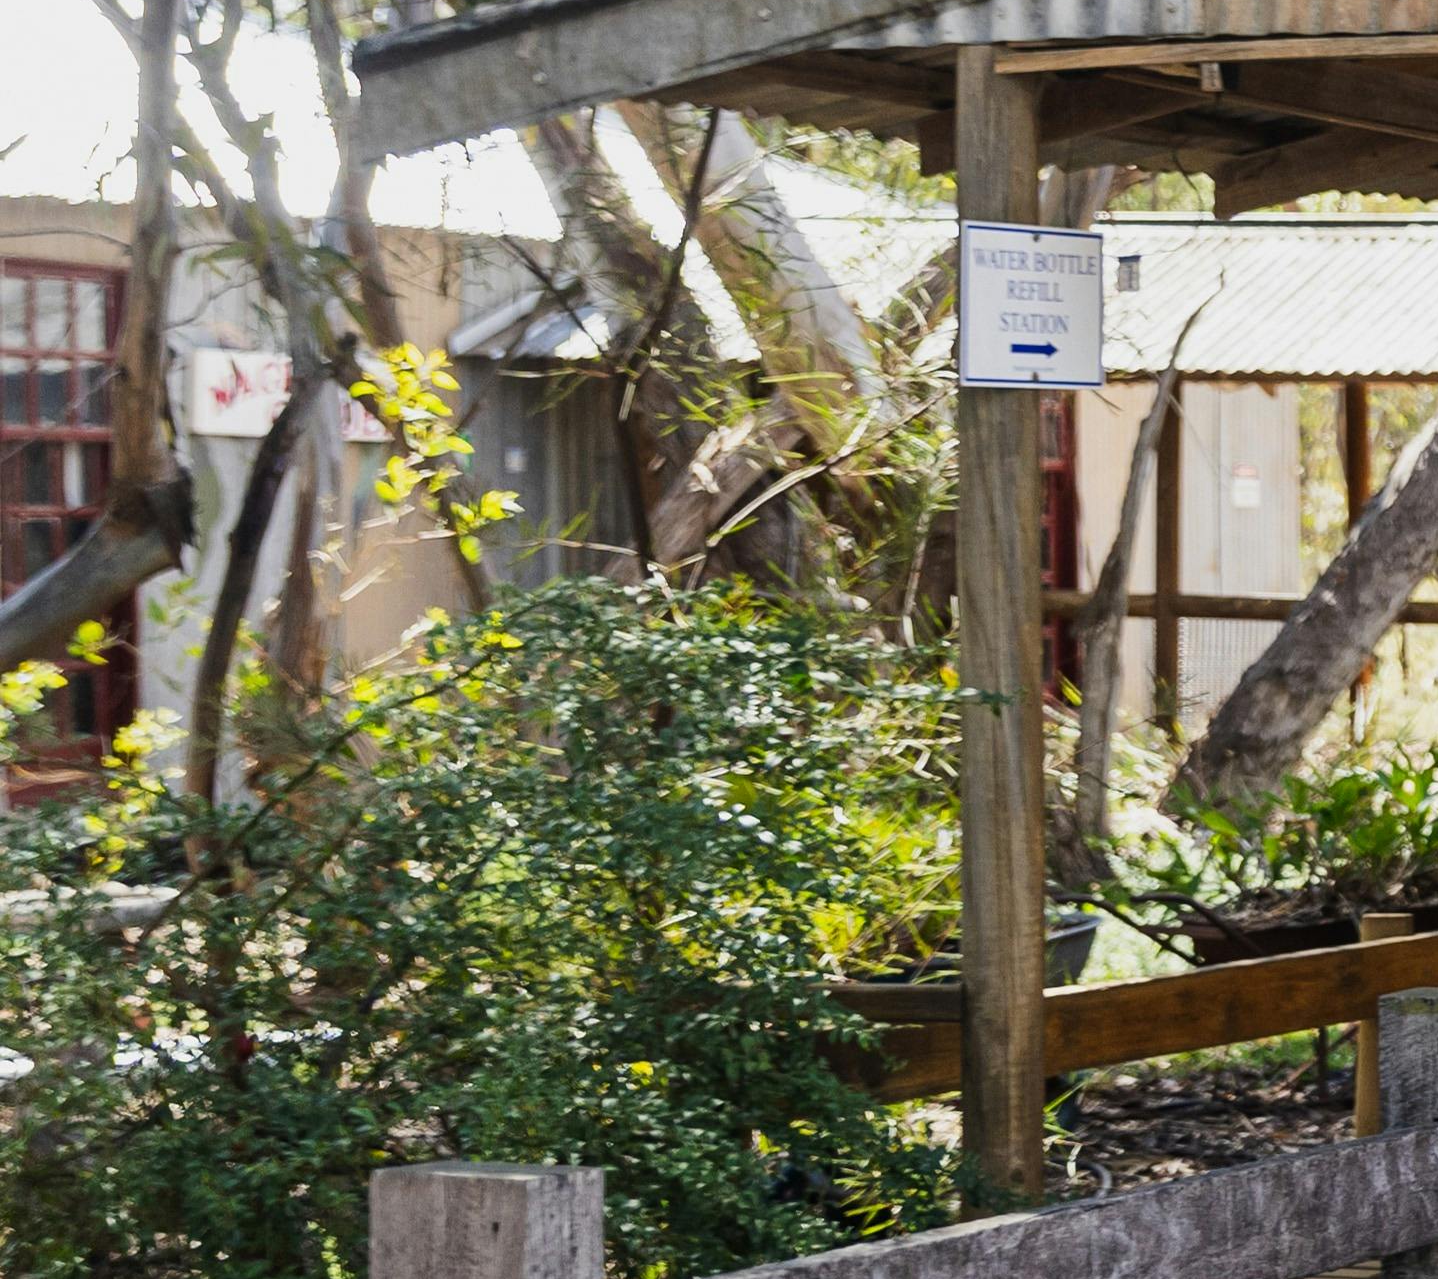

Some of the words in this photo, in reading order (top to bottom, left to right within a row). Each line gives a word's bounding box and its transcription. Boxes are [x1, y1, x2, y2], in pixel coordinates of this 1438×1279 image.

[972, 247, 1030, 272] WATER
[1033, 251, 1097, 276] BOTTLE
[1006, 280, 1064, 302] REFILL
[1000, 312, 1069, 334] STATION
